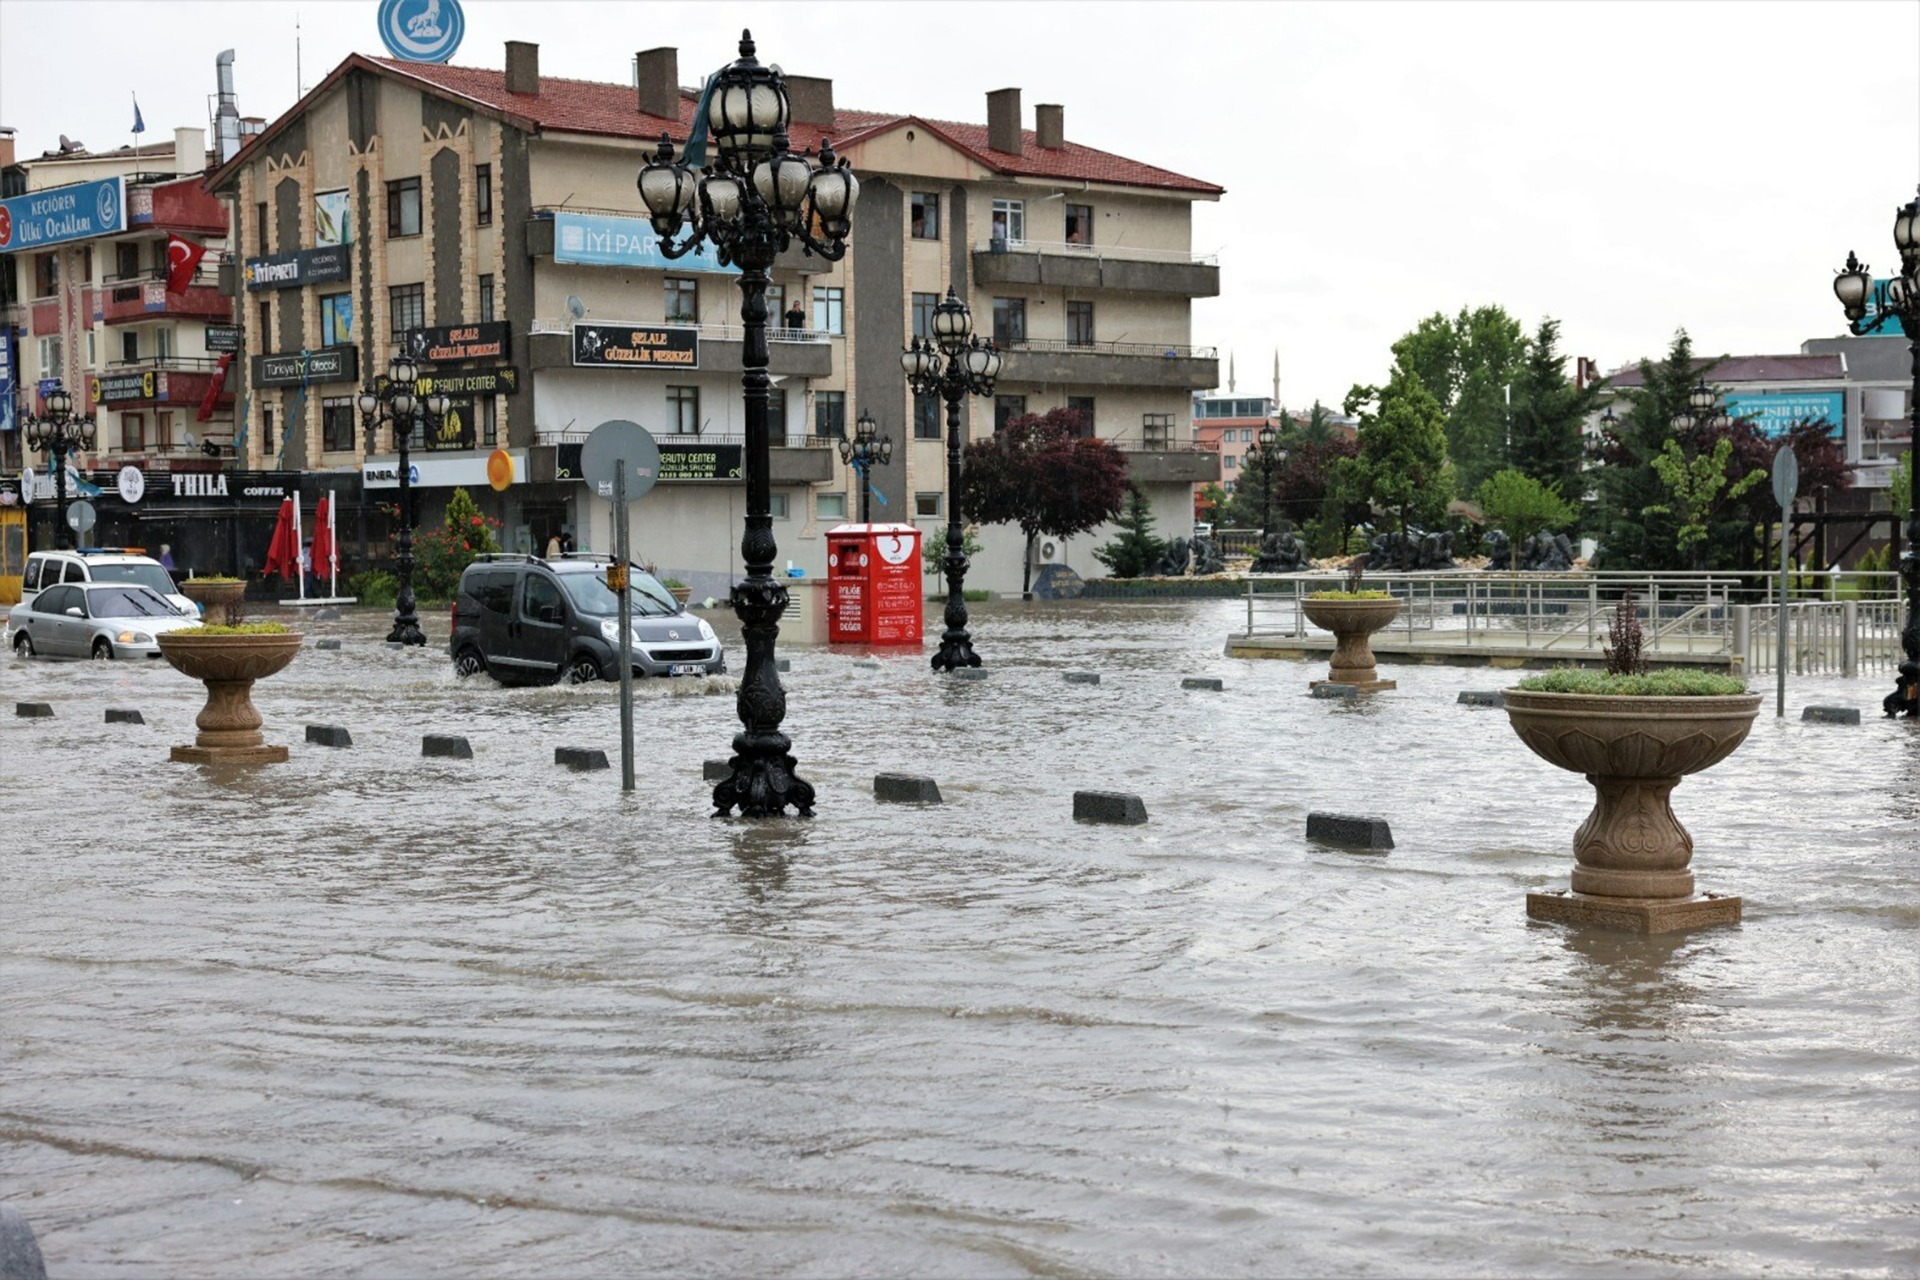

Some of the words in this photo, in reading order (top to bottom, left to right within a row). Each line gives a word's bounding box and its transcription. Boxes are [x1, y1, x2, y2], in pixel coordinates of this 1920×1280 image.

[31, 194, 76, 216] KEÇİÖREN
[587, 228, 611, 254] İYİ
[449, 327, 479, 345] ŞELALE
[631, 332, 667, 347] ŞELALE
[605, 345, 651, 361] GÜZELLİK
[653, 348, 693, 363] MERKEZİ
[266, 363, 295, 376] Türkiye
[310, 359, 338, 372] Olacak
[466, 375, 496, 391] CENTER
[688, 453, 716, 463] CENTER
[171, 474, 229, 496] THILA
[243, 487, 284, 496] COFFEE
